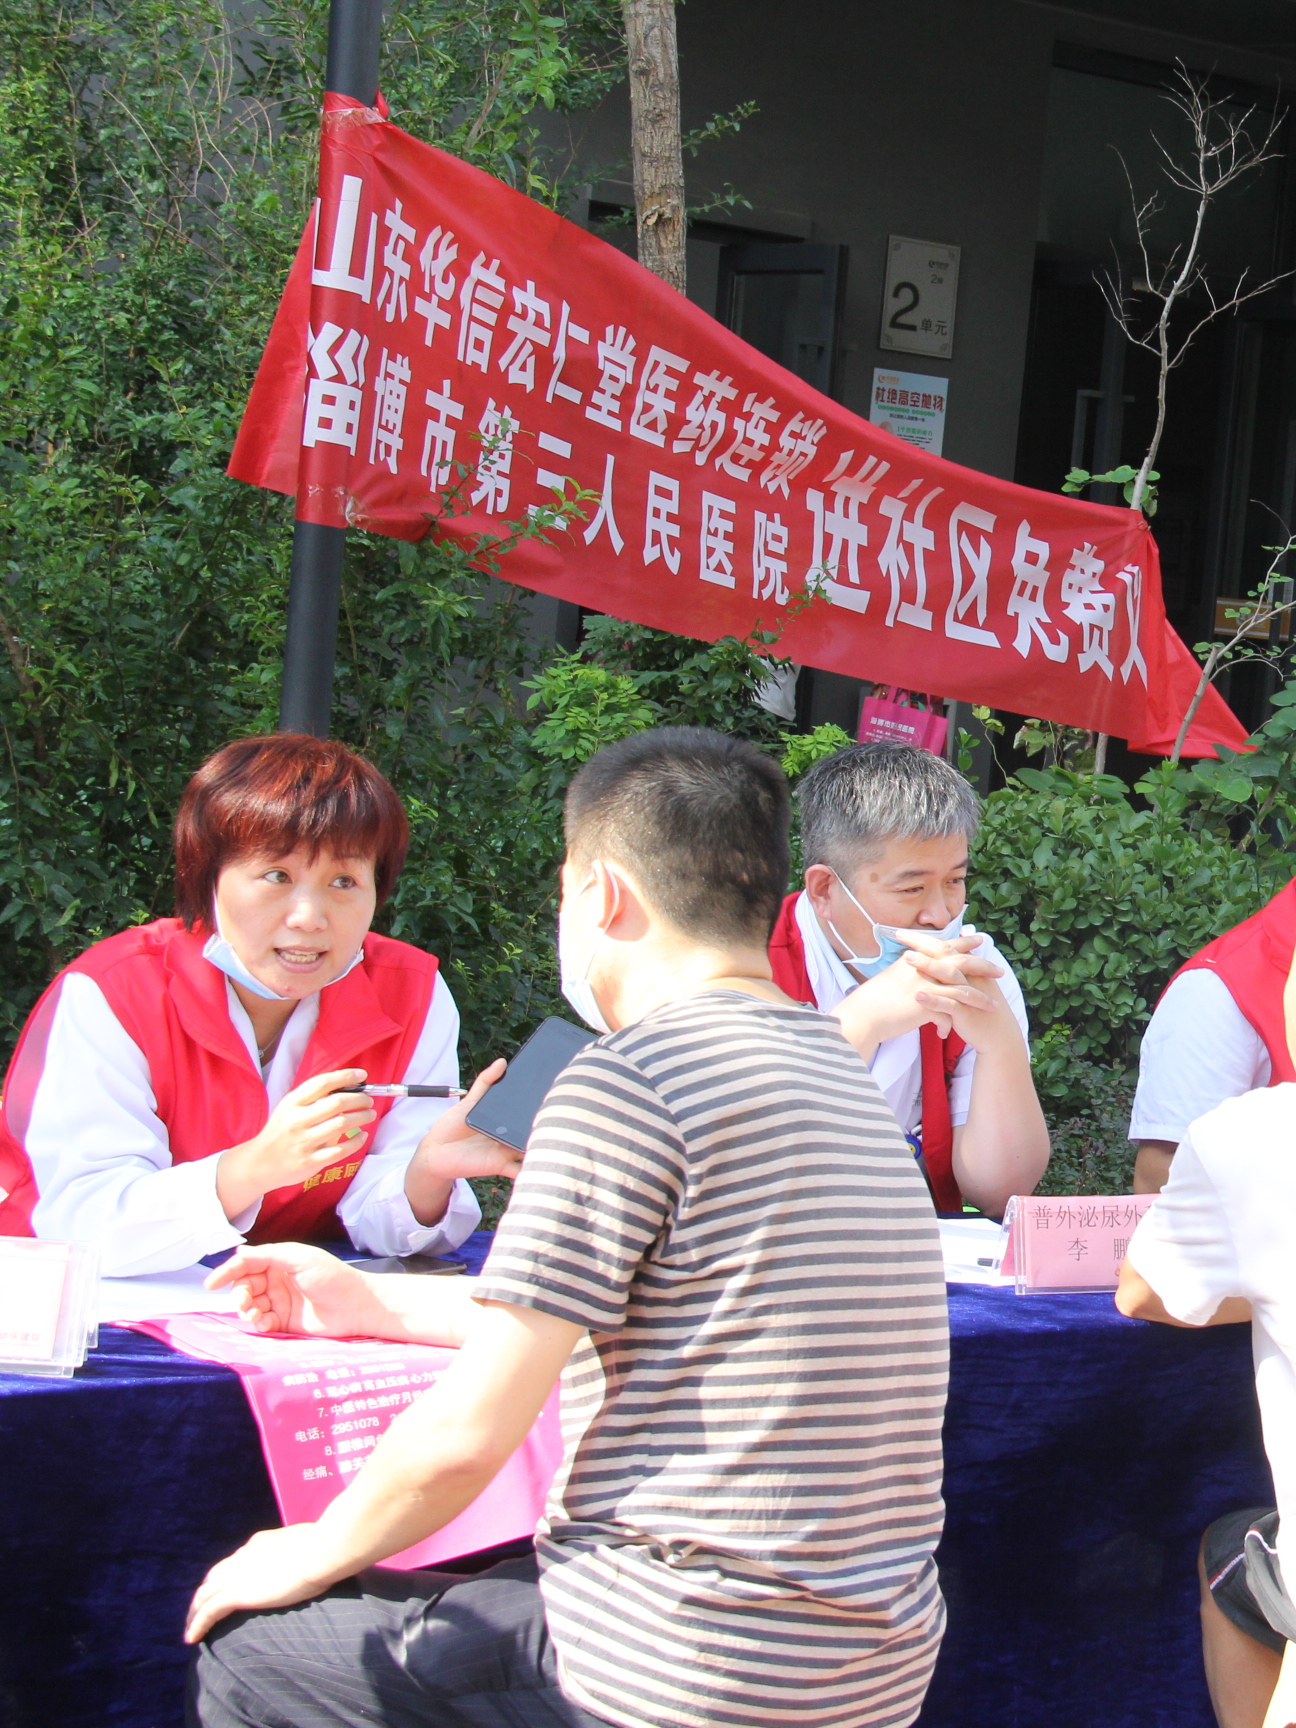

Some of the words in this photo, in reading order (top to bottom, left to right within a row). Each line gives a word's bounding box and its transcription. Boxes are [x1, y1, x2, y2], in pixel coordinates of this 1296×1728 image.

[311, 174, 827, 500] 山东华信宏仁堂医药连锁
[875, 386, 944, 410] 杜绝高空抛物
[1032, 1205, 1149, 1229] 普外泌尿外
